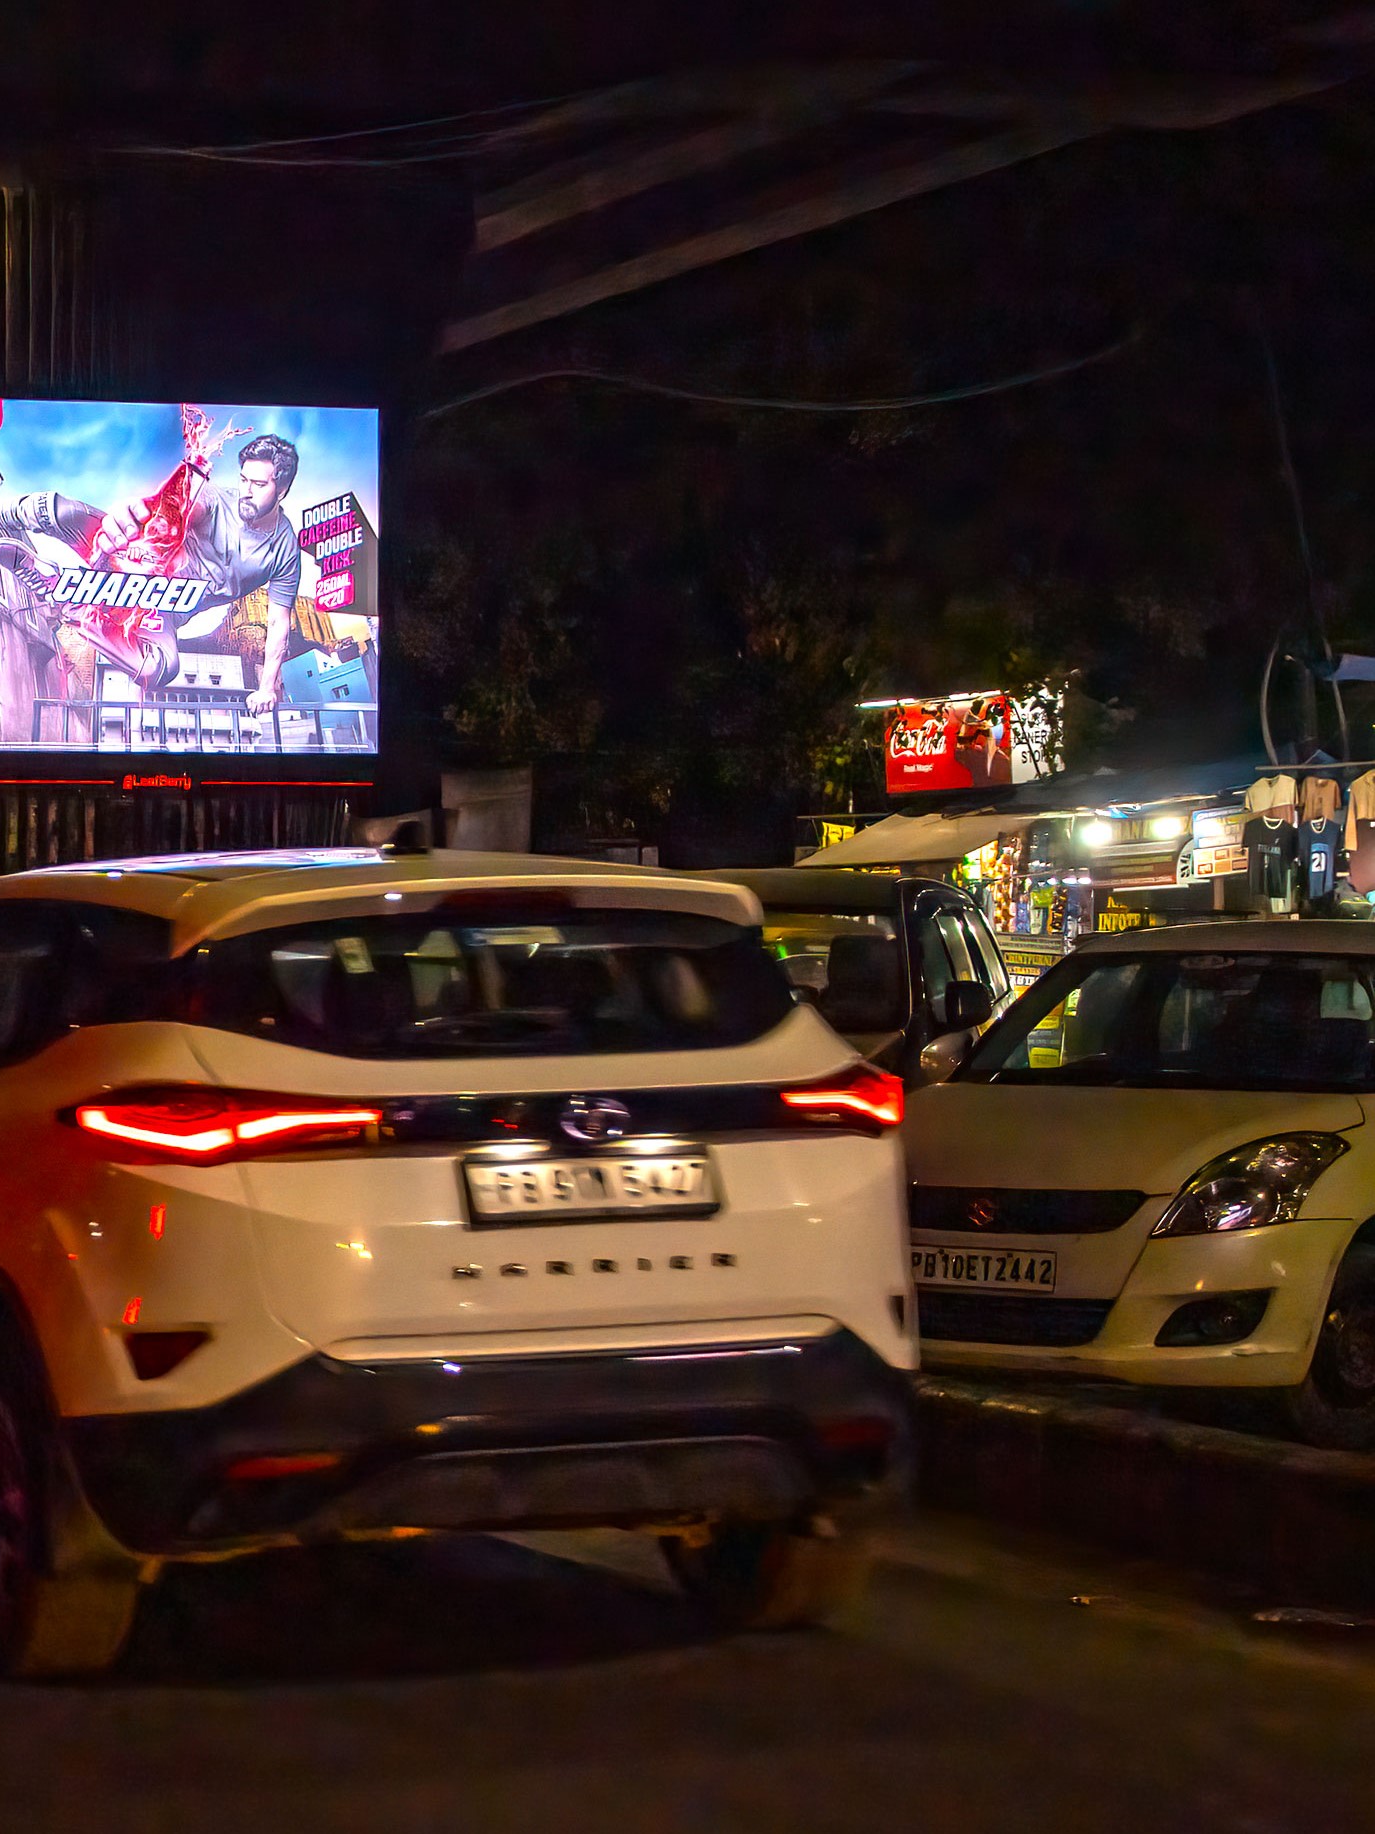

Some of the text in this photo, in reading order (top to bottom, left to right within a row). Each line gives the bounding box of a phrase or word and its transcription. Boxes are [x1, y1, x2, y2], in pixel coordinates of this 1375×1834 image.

[304, 495, 351, 528] DOUBLE
[315, 526, 363, 560] DOUBLE
[52, 566, 211, 613] CHARGED
[1311, 852, 1326, 872] 21
